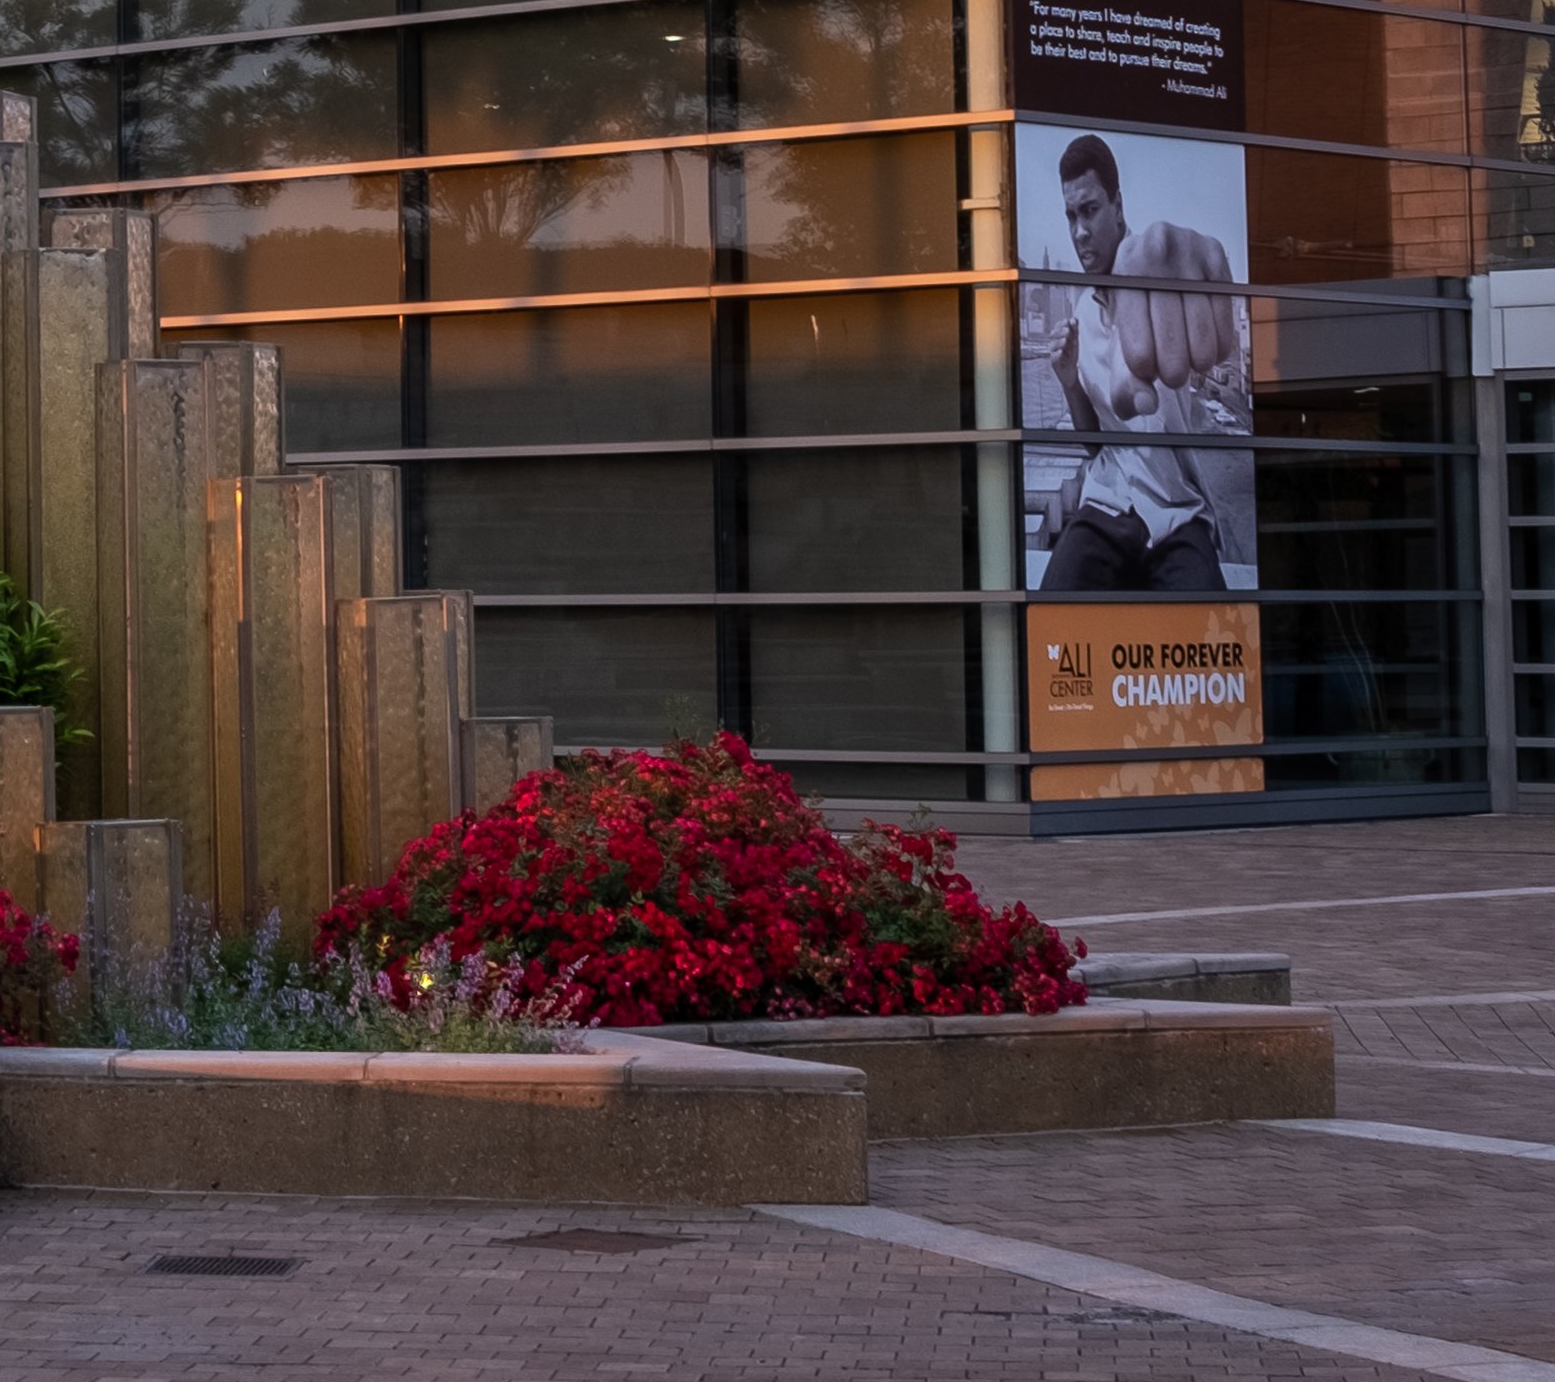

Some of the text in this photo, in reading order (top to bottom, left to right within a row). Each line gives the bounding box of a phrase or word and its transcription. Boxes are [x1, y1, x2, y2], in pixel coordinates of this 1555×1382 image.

[1051, 6, 1076, 22] many
[1078, 10, 1102, 23] years
[1104, 8, 1108, 21] I
[1109, 8, 1131, 24] have
[1133, 11, 1172, 30] dreamed
[1174, 17, 1184, 31] of
[1186, 22, 1221, 40] creating
[1030, 21, 1224, 58] a place to share, teach and inspire people to
[1030, 40, 1043, 55] be
[1045, 41, 1066, 57] their
[1068, 44, 1087, 59] best
[1089, 47, 1106, 62] and
[1108, 50, 1118, 63] to
[1119, 51, 1149, 67] pursue
[1151, 53, 1172, 69] their
[1167, 78, 1215, 97] Muhammad
[1216, 86, 1227, 99] Ali
[1059, 643, 1091, 678] ALI
[1112, 642, 1244, 670] OUR FOREVER
[1050, 680, 1094, 697] CENTER
[1112, 672, 1245, 707] CHAMPION
